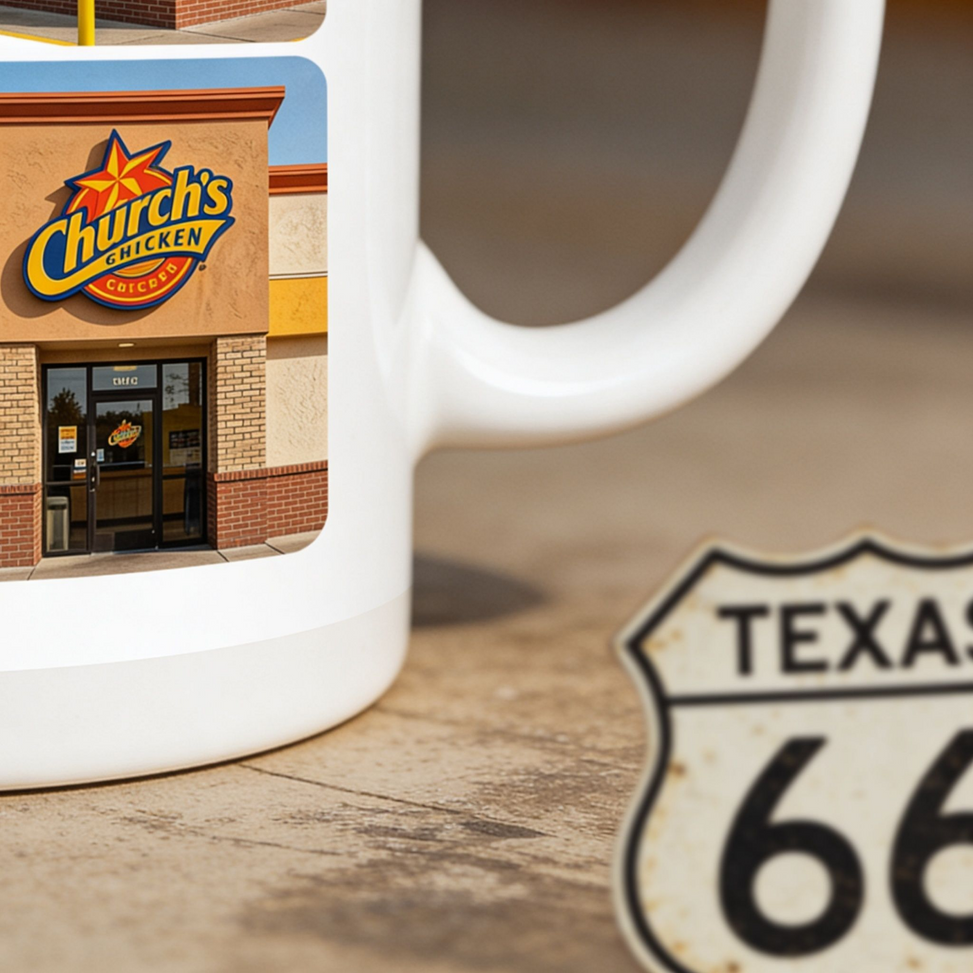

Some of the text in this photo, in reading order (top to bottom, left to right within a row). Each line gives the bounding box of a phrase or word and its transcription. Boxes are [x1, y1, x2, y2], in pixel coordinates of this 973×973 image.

[27, 169, 228, 297] Church's
[717, 598, 973, 677] TEXA
[718, 726, 973, 959] 66
